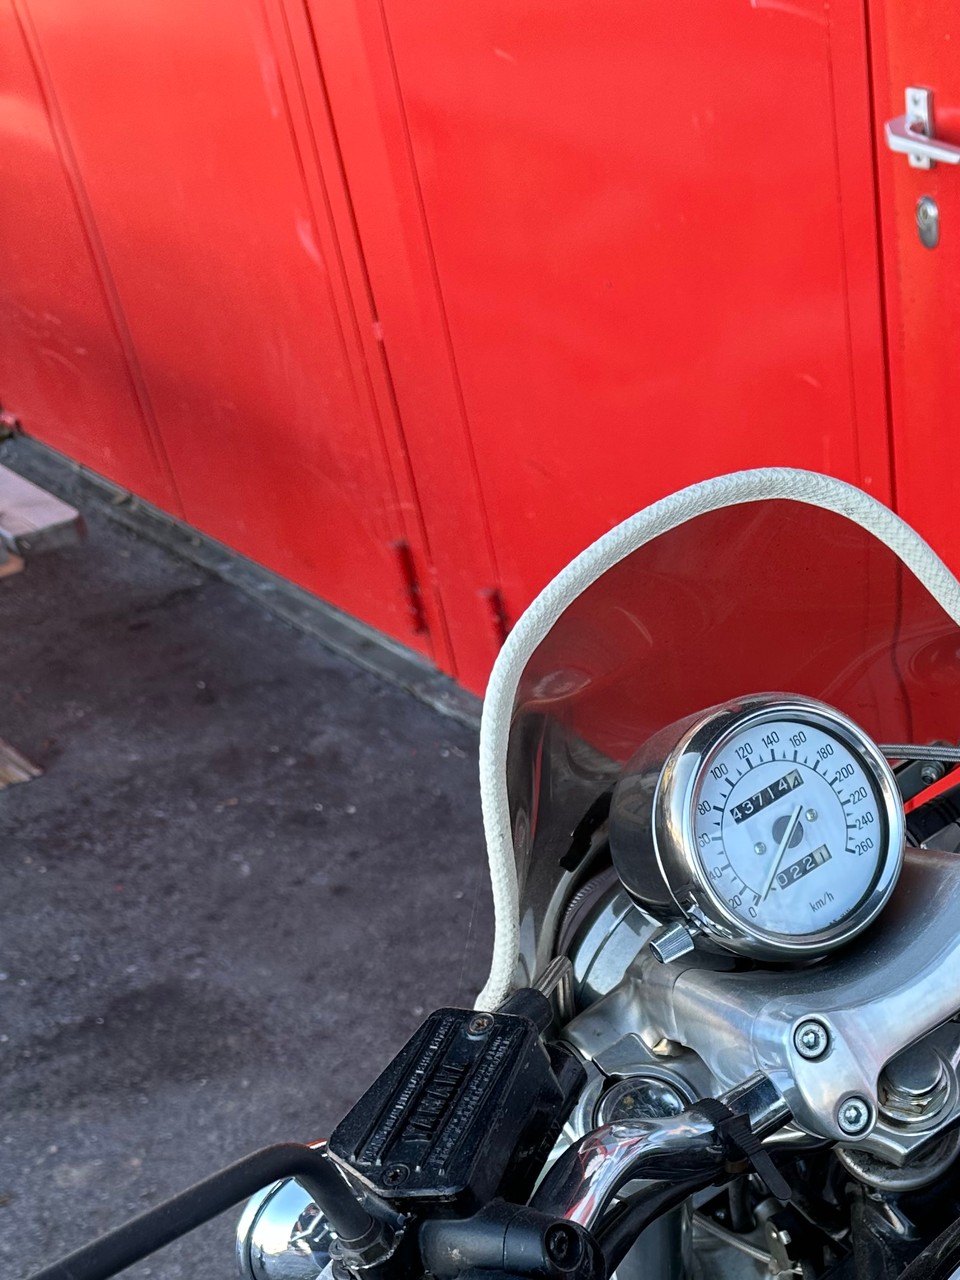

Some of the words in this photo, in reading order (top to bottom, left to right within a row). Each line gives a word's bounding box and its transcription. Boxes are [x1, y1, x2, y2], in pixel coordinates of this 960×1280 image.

[762, 731, 780, 749] 140
[789, 731, 807, 748] 160
[735, 742, 753, 760] 120
[817, 743, 834, 761] 180
[710, 762, 729, 781] 100
[835, 763, 855, 783] 200
[849, 786, 868, 805] 220
[698, 800, 712, 816] 80
[855, 811, 874, 830] 240
[698, 832, 711, 848] 60
[854, 837, 874, 856] 260
[709, 867, 723, 881] 40
[729, 894, 743, 909] 20
[809, 891, 835, 913] km/h
[748, 906, 758, 918] 0
